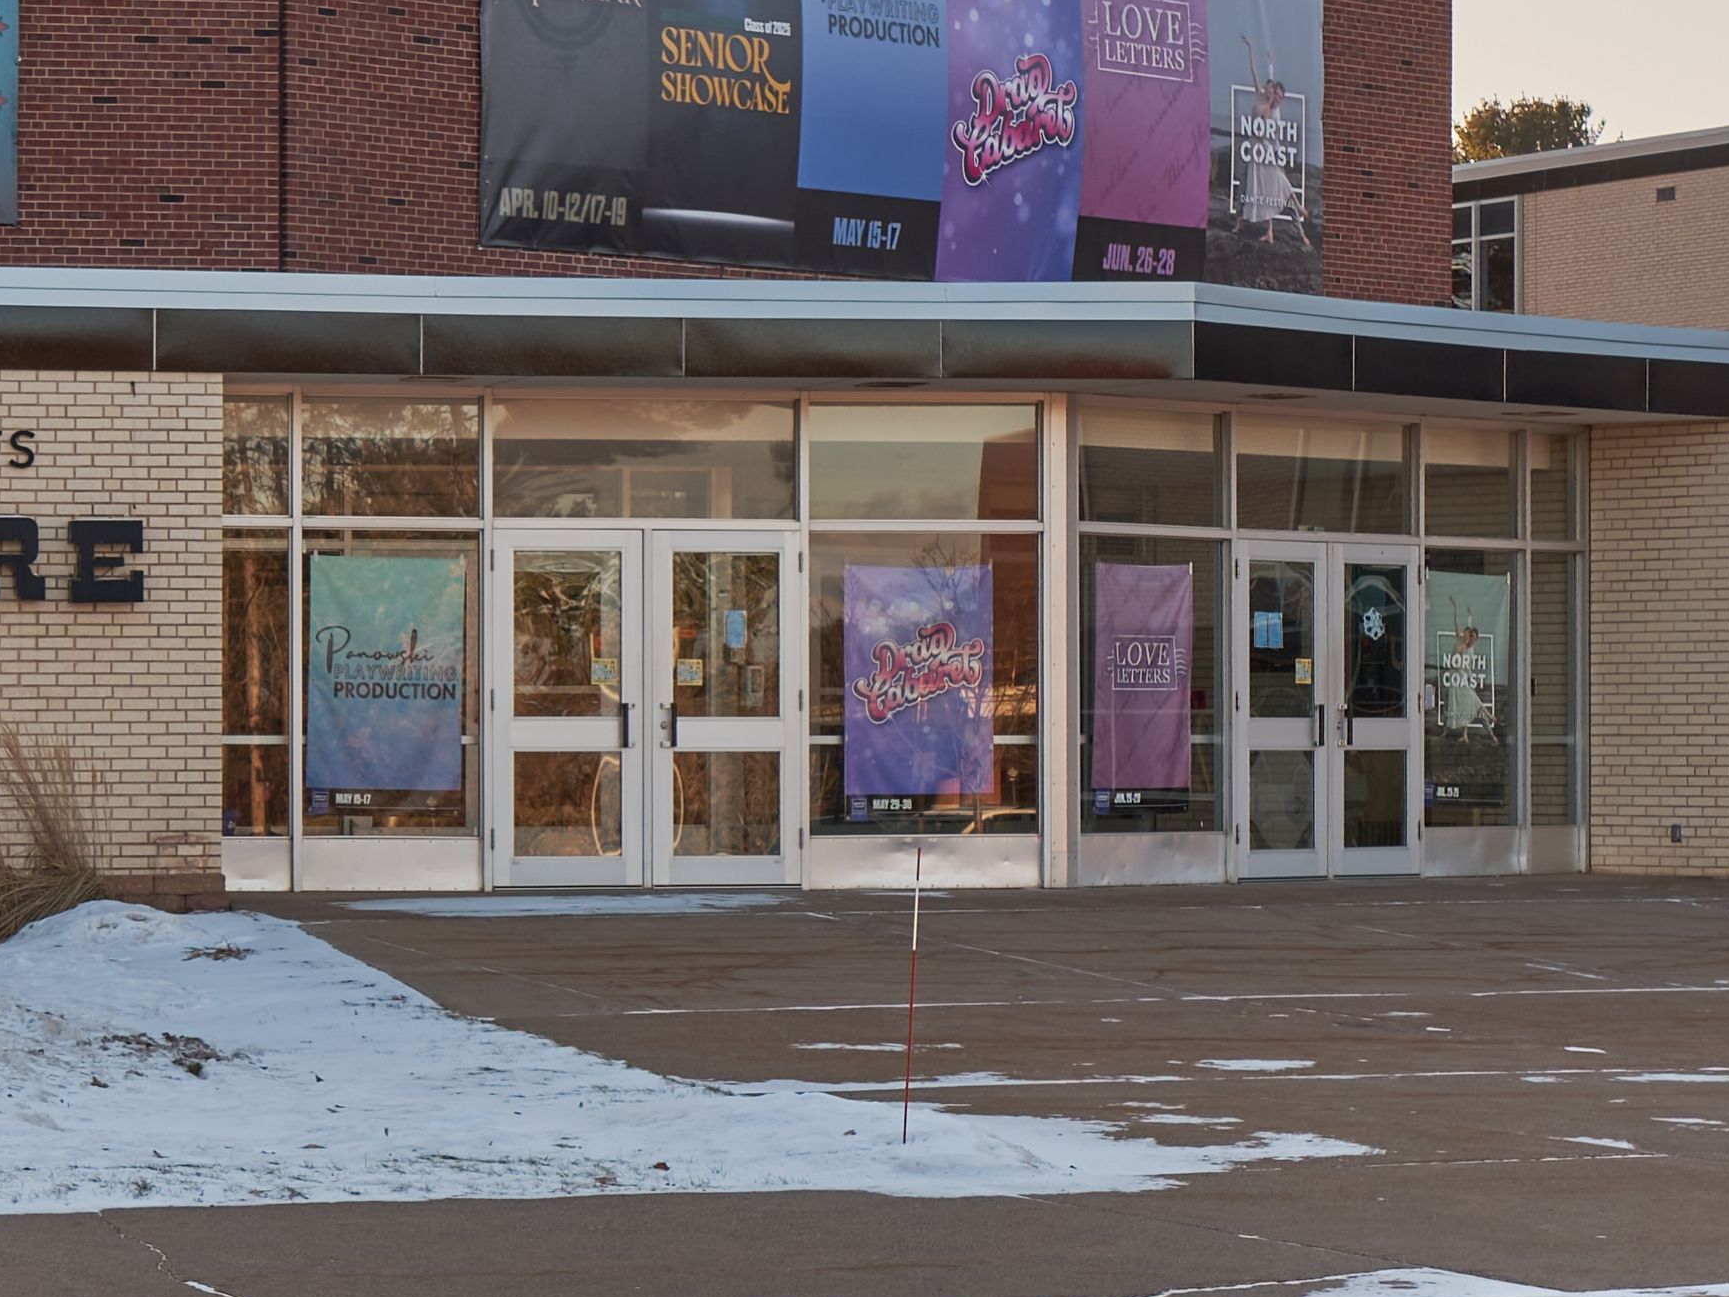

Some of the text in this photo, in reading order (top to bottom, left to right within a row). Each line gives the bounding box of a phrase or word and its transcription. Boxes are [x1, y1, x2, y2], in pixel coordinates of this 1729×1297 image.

[828, 13, 940, 48] PRODUCTION
[1102, 0, 1184, 45] LOVE
[661, 26, 791, 91] SENIOR
[1104, 39, 1185, 71] LETTERS
[661, 71, 790, 114] SHOWCASE
[971, 53, 1052, 120] Drag
[951, 80, 1077, 186] Cabaret
[1240, 115, 1297, 142] NORTH
[1240, 141, 1297, 168] COAST
[499, 187, 628, 226] APR. 10-12/17-19
[833, 216, 902, 250] MAY 15-17
[1102, 243, 1176, 276] JUN. 26-28
[315, 625, 435, 674] Panowski
[871, 621, 956, 677] Drag
[1115, 641, 1170, 666] LOVE
[1442, 653, 1486, 670] NORTH
[334, 663, 457, 682] PLAYWRITING
[851, 638, 984, 724] Cabaret
[1116, 668, 1171, 684] LETTERS
[1442, 672, 1486, 689] COAST
[333, 681, 456, 701] PRODUCTION
